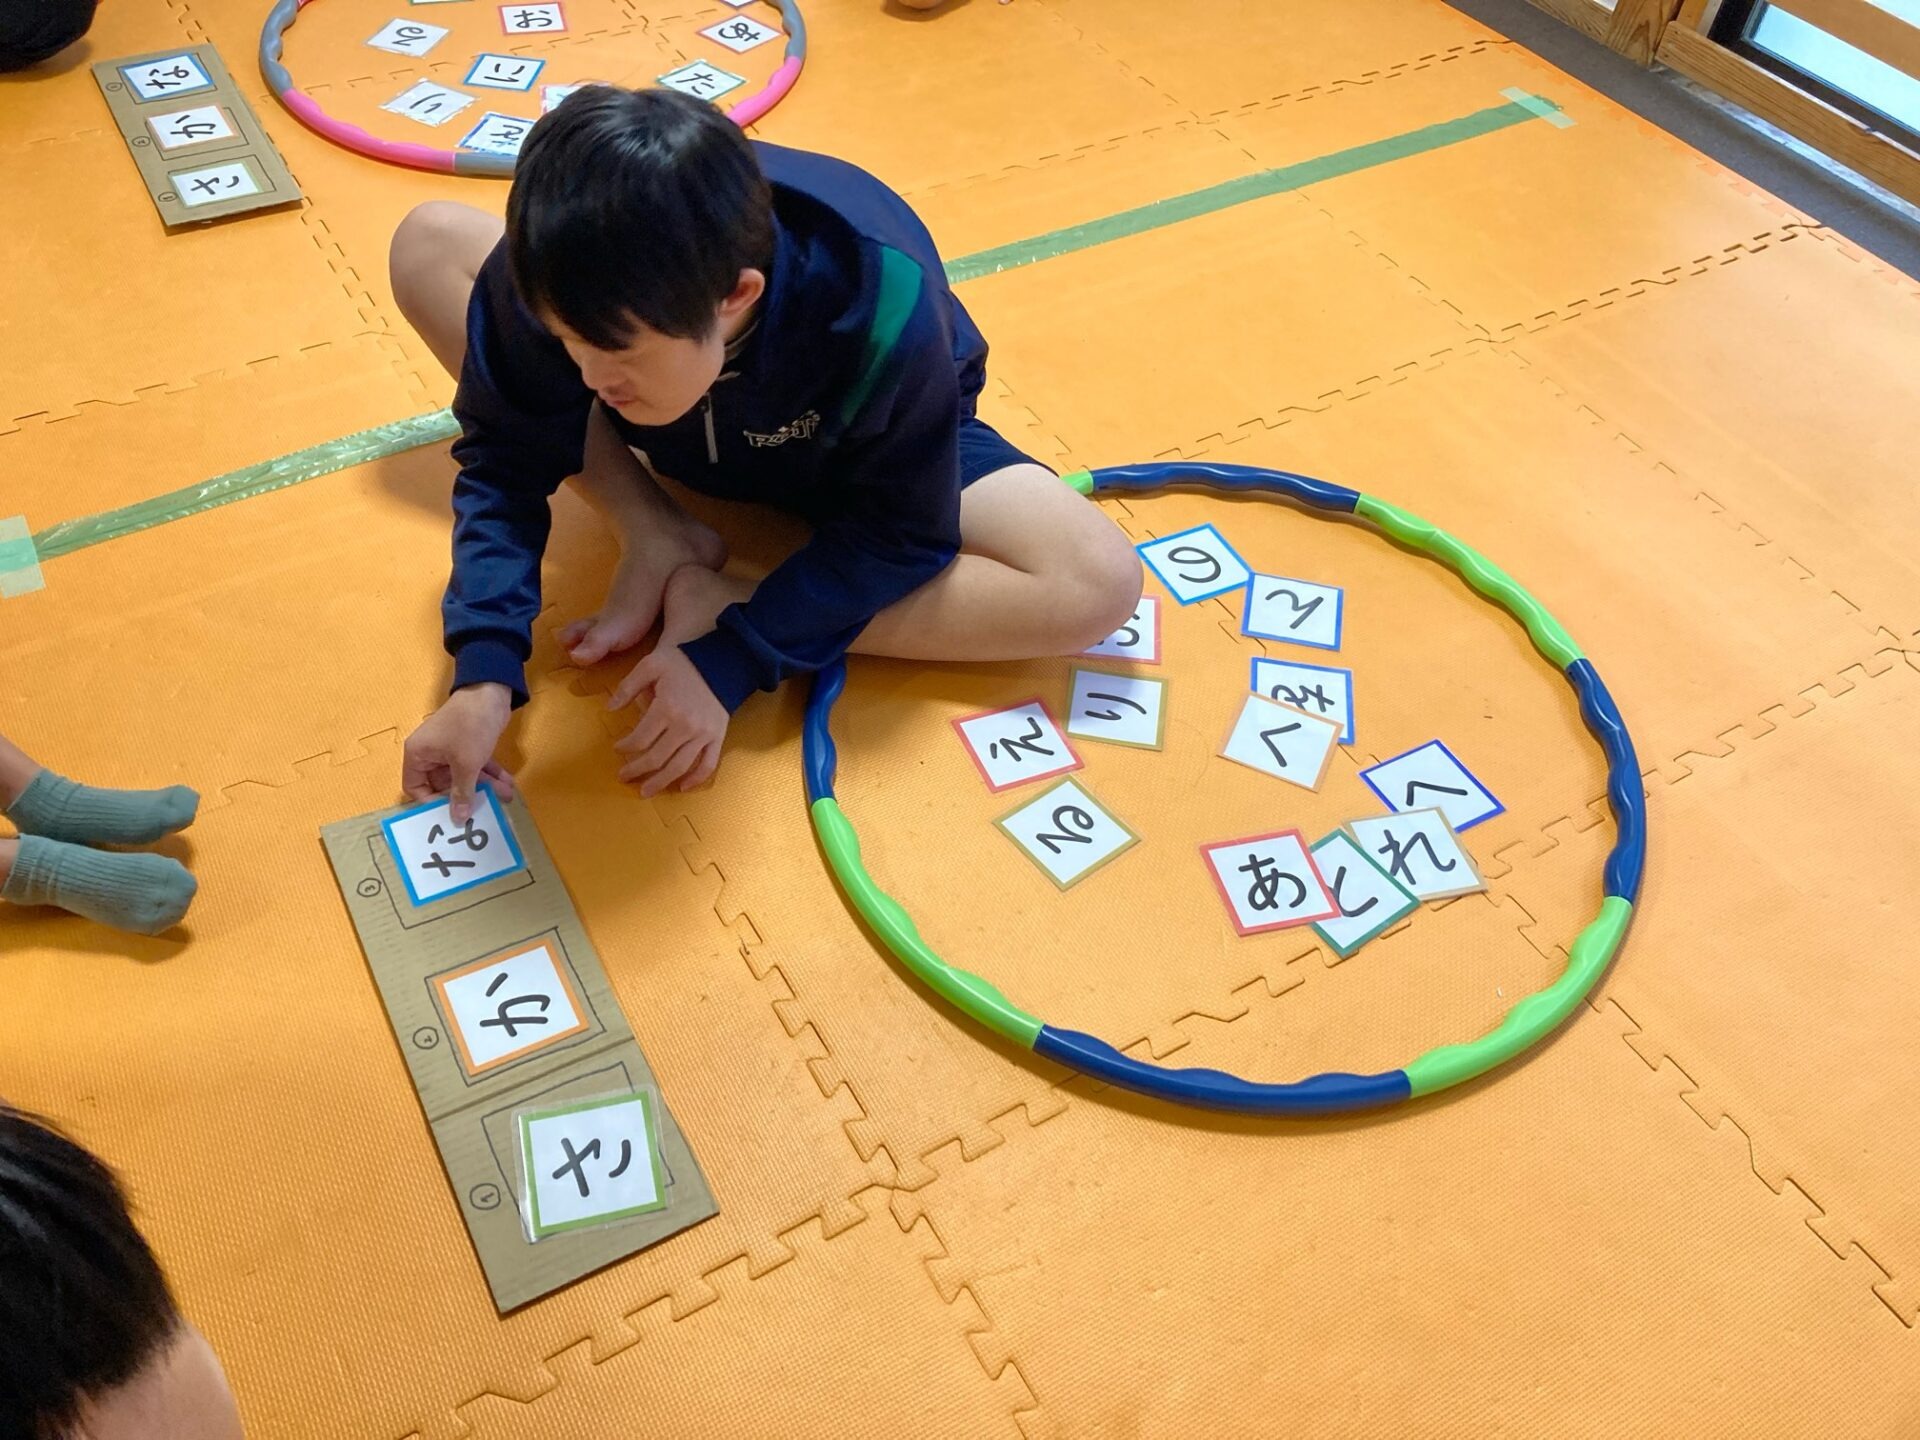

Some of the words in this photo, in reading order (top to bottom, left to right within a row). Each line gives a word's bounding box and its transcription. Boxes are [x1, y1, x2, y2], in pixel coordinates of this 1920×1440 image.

[514, 10, 553, 28] お
[146, 65, 189, 89] な
[484, 63, 525, 83] に
[674, 72, 715, 95] た
[170, 114, 216, 139] か
[191, 176, 240, 195] さ
[1167, 545, 1222, 586] の
[1265, 589, 1324, 629] ん
[1084, 692, 1147, 721] り
[989, 715, 1054, 763] え
[1260, 722, 1302, 767] く
[420, 817, 489, 878] な
[1036, 805, 1094, 854] る
[1377, 828, 1457, 885] れ
[1238, 853, 1307, 911] あ
[479, 972, 551, 1037] か
[552, 1138, 632, 1198] さ
